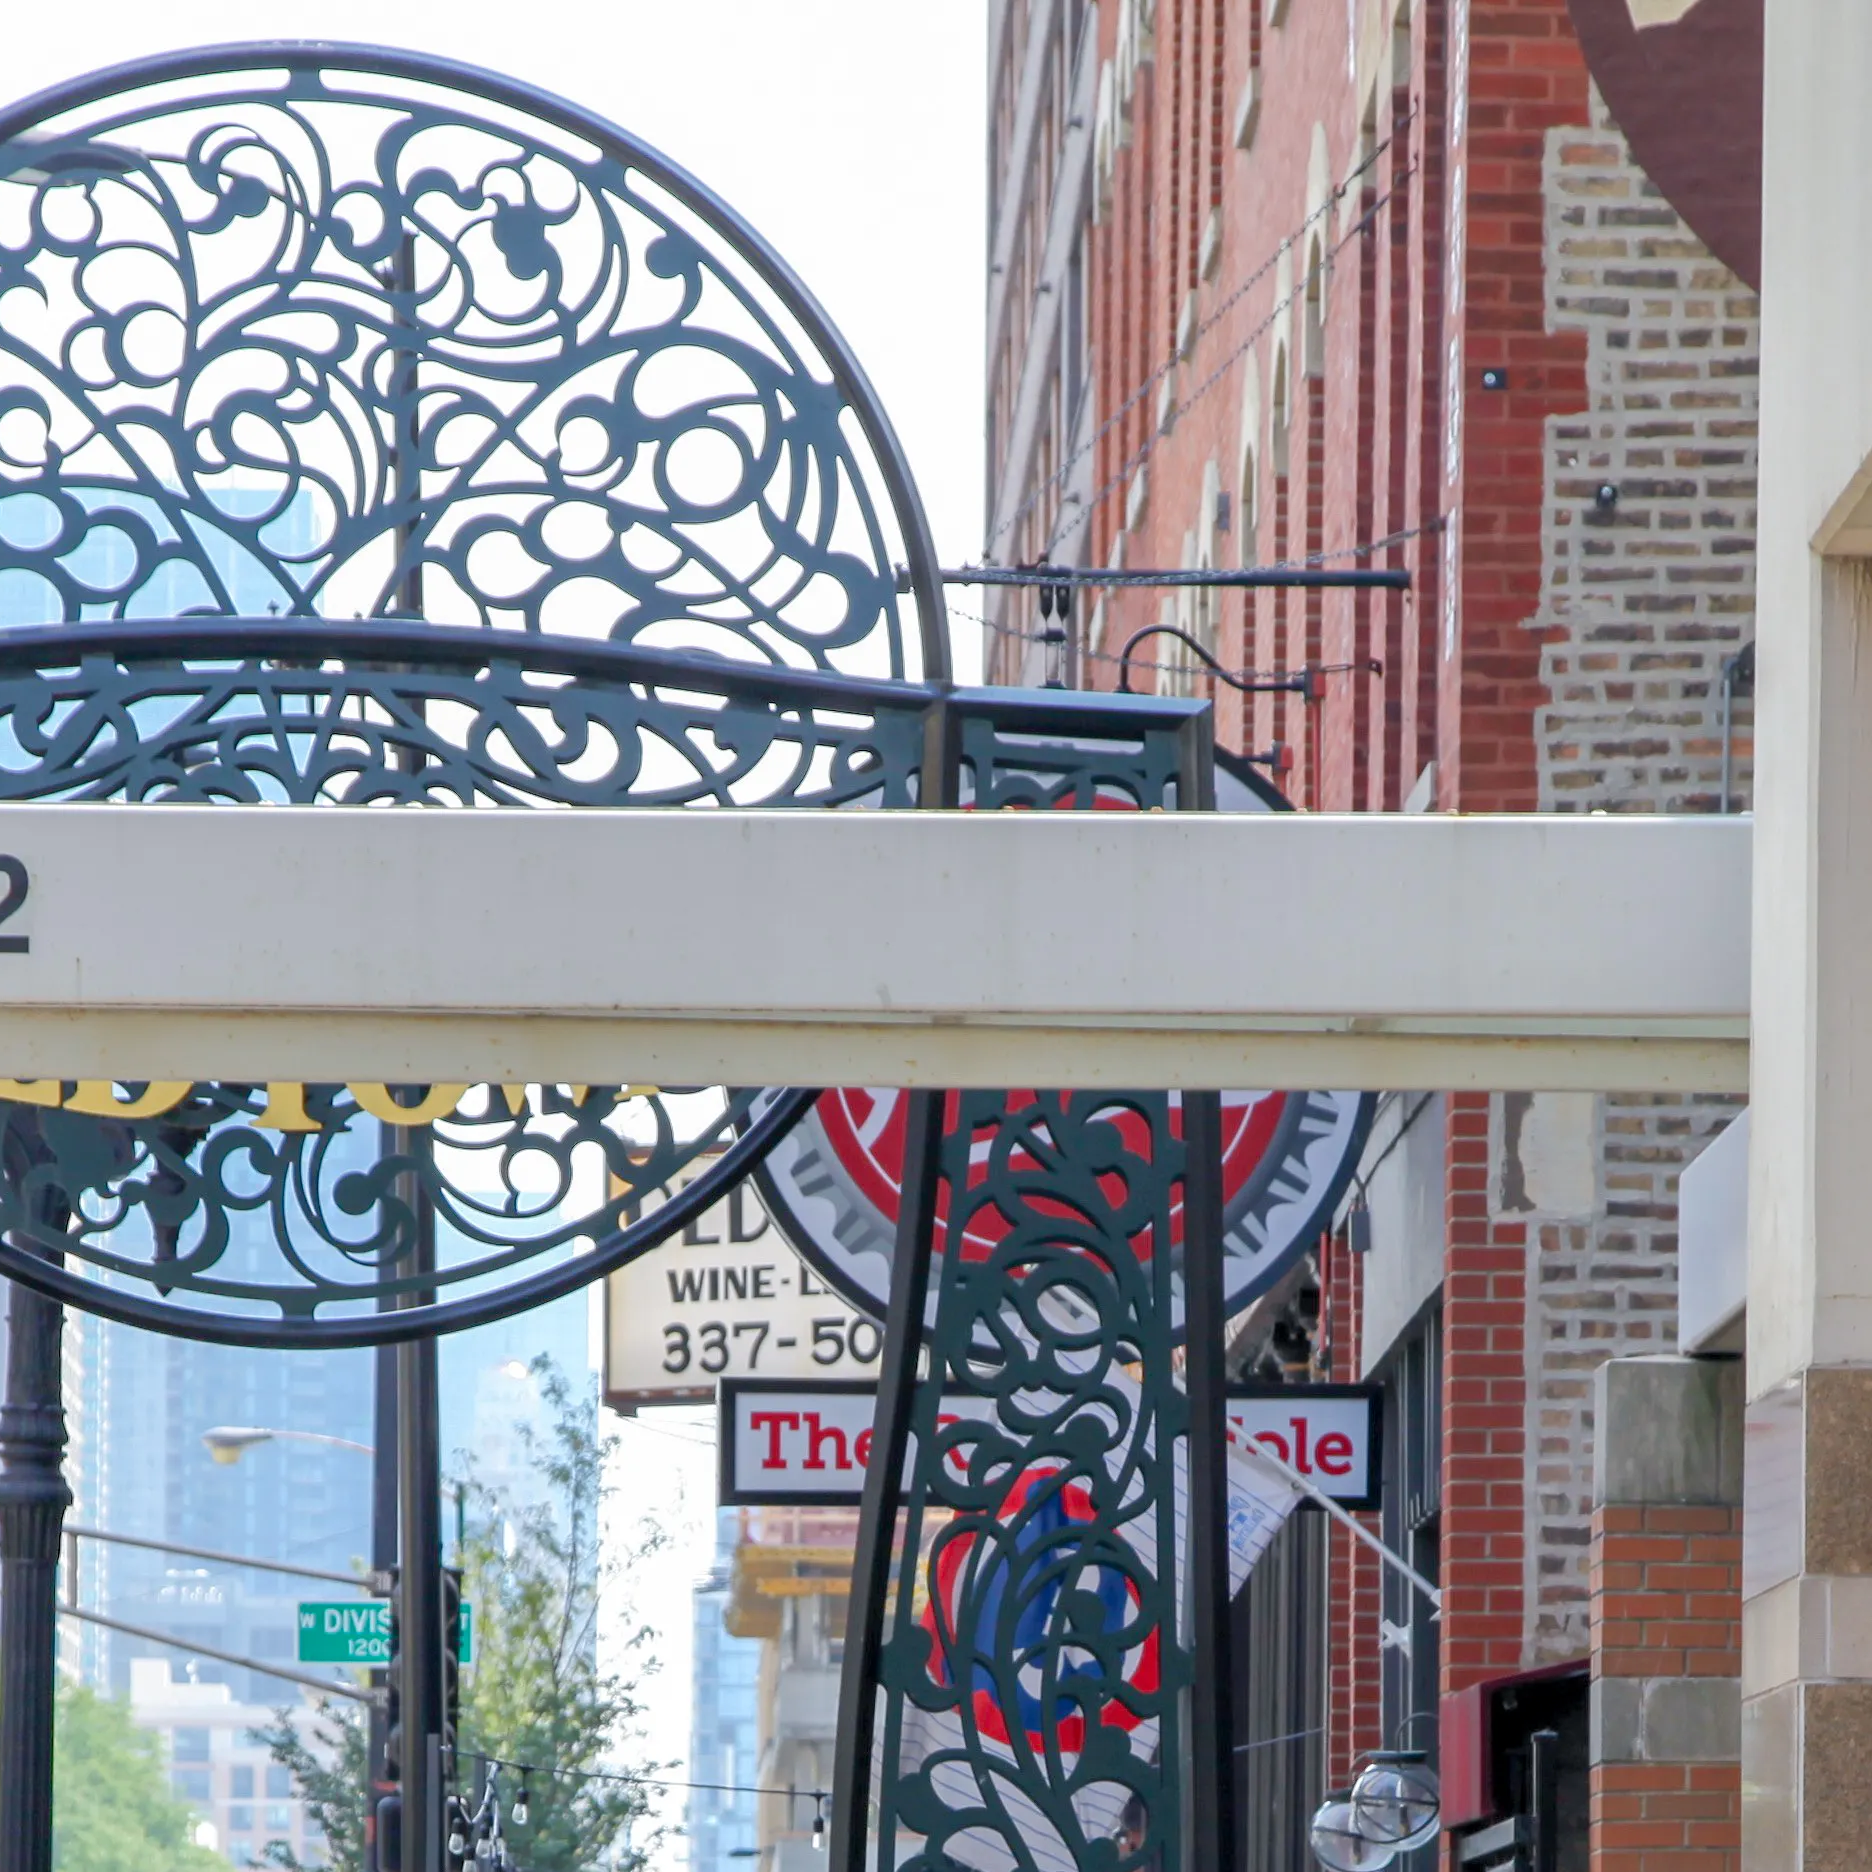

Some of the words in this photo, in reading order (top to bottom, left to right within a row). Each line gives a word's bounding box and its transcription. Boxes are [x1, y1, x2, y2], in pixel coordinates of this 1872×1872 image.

[662, 1316, 881, 1373] 337-50
[300, 1612, 315, 1629] W
[324, 1608, 392, 1634] DIVIS
